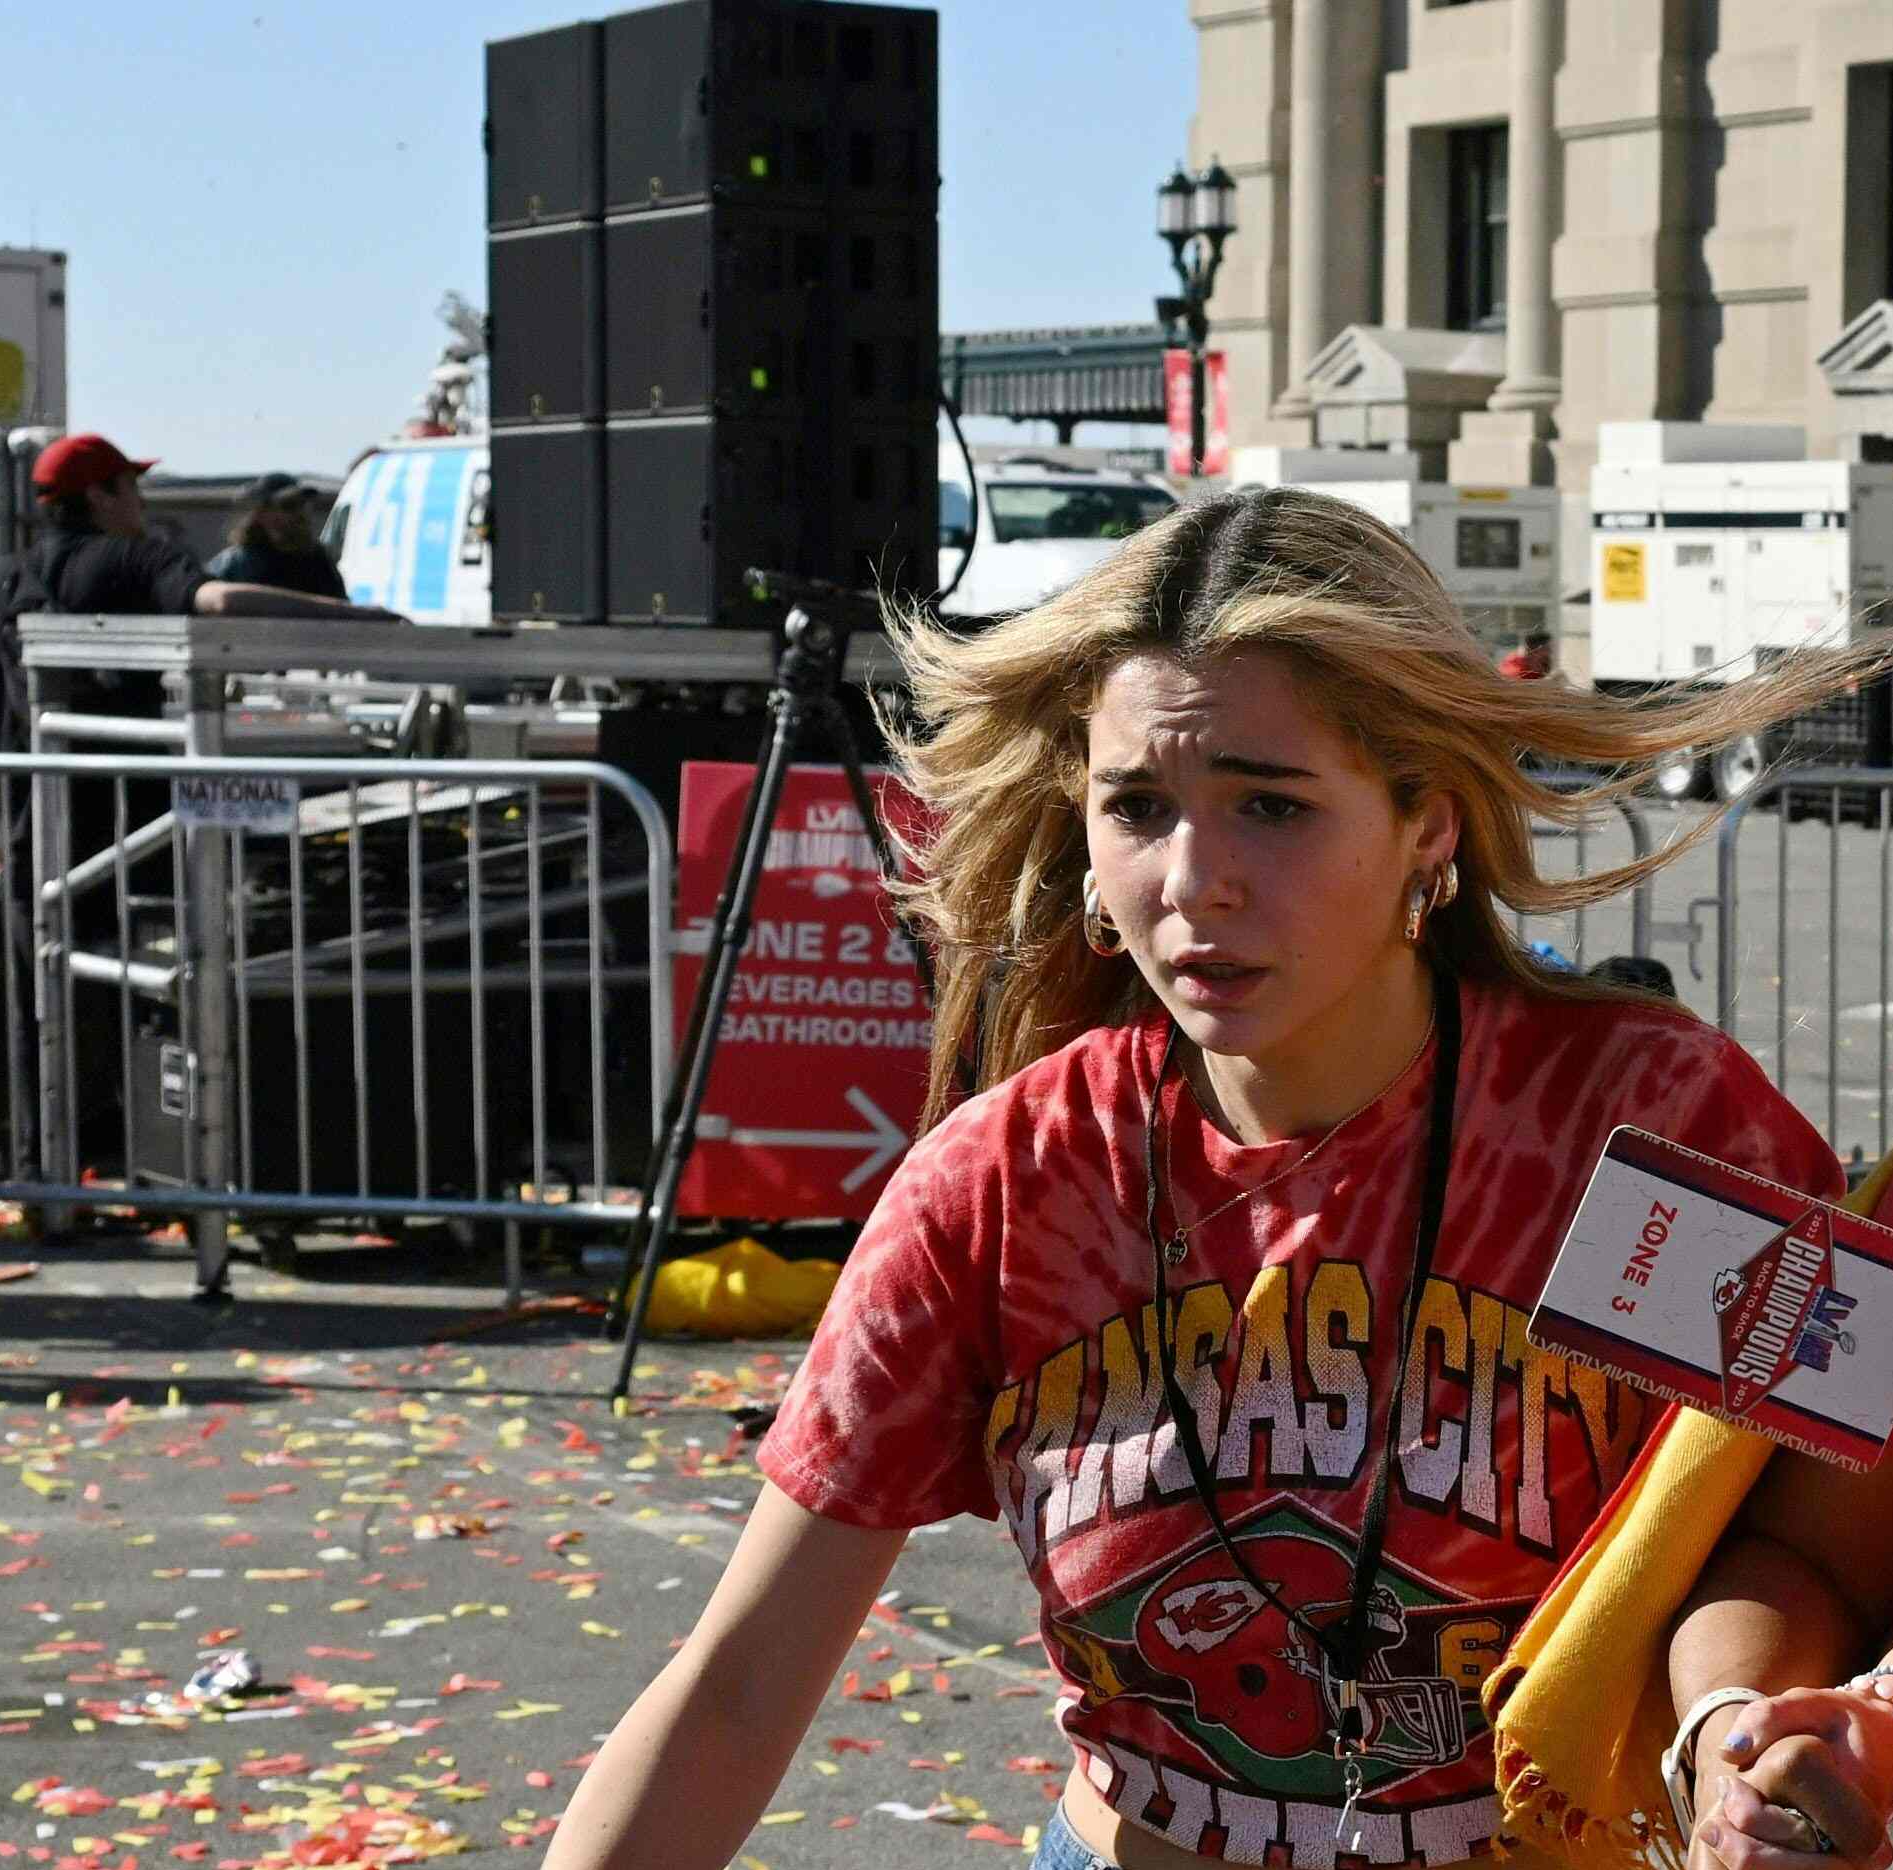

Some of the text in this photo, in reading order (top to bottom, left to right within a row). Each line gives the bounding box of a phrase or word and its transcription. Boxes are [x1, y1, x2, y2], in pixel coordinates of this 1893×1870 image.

[174, 779, 289, 801] NATIONAL
[838, 925, 872, 964] 2
[727, 972, 916, 1009] EVERAGES
[1621, 1199, 1678, 1289] ZONE
[1611, 1295, 1637, 1316] 3
[1729, 1235, 1826, 1387] CHAMPIONS
